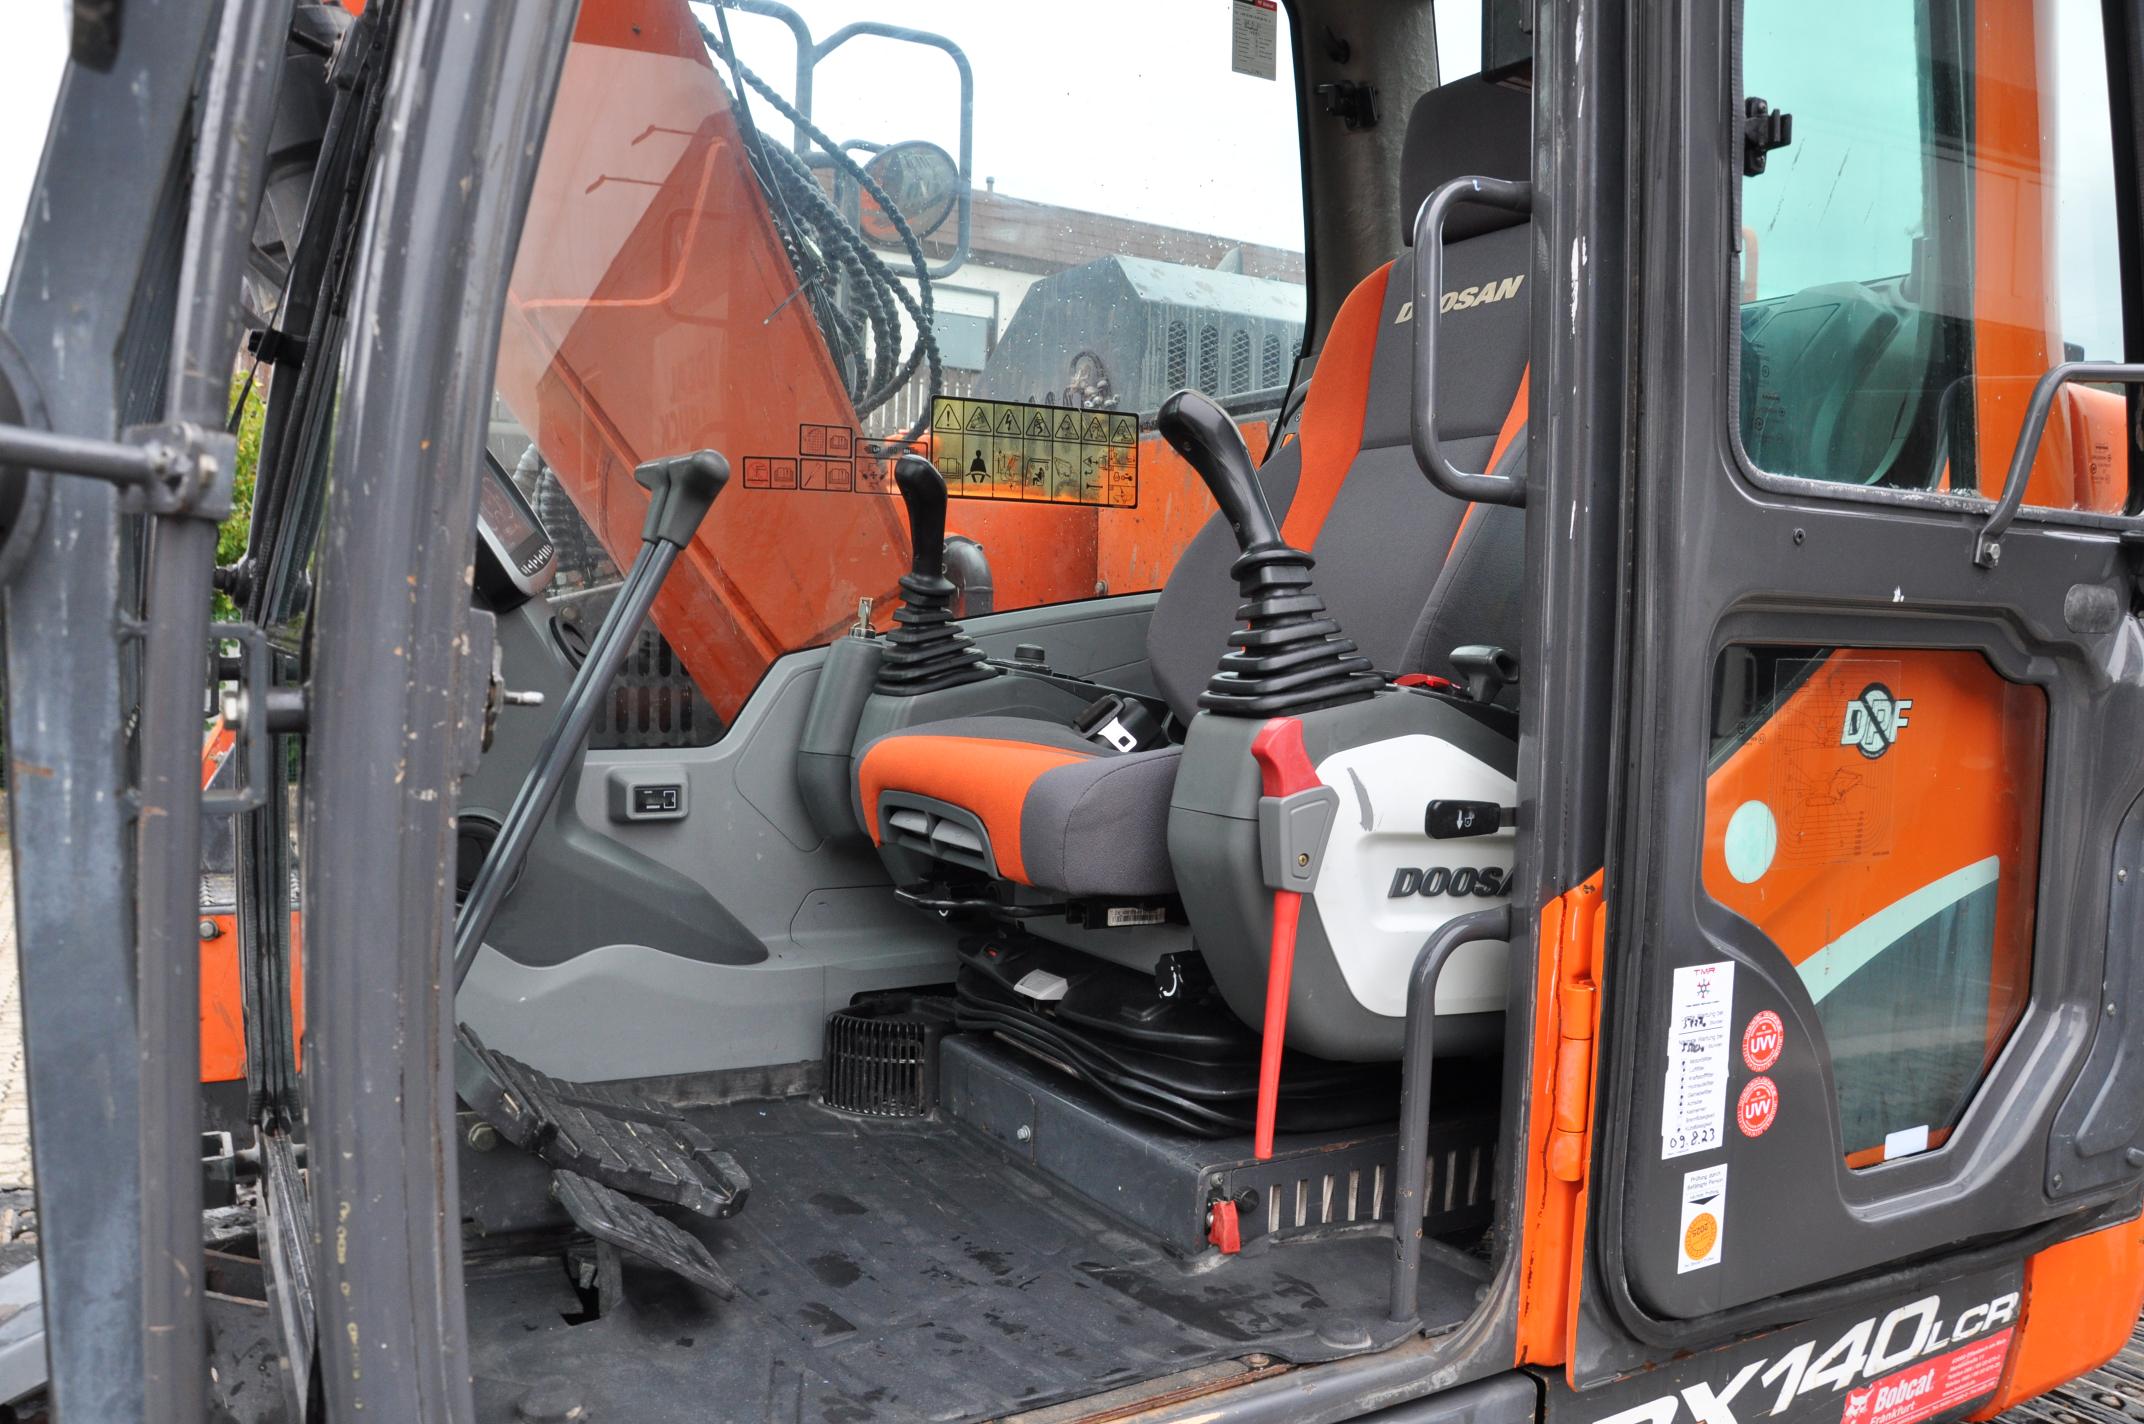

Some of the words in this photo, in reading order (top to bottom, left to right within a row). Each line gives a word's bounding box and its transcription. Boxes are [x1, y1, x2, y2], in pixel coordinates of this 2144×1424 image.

[1394, 274, 1525, 324] DOSAN
[1840, 699, 1914, 747] DPF
[1750, 1034, 1777, 1054] UVV
[1745, 1098, 1771, 1119] UVV
[1873, 1368, 1936, 1414] Bobcat
[1870, 1402, 1916, 1424] Frankfurt
